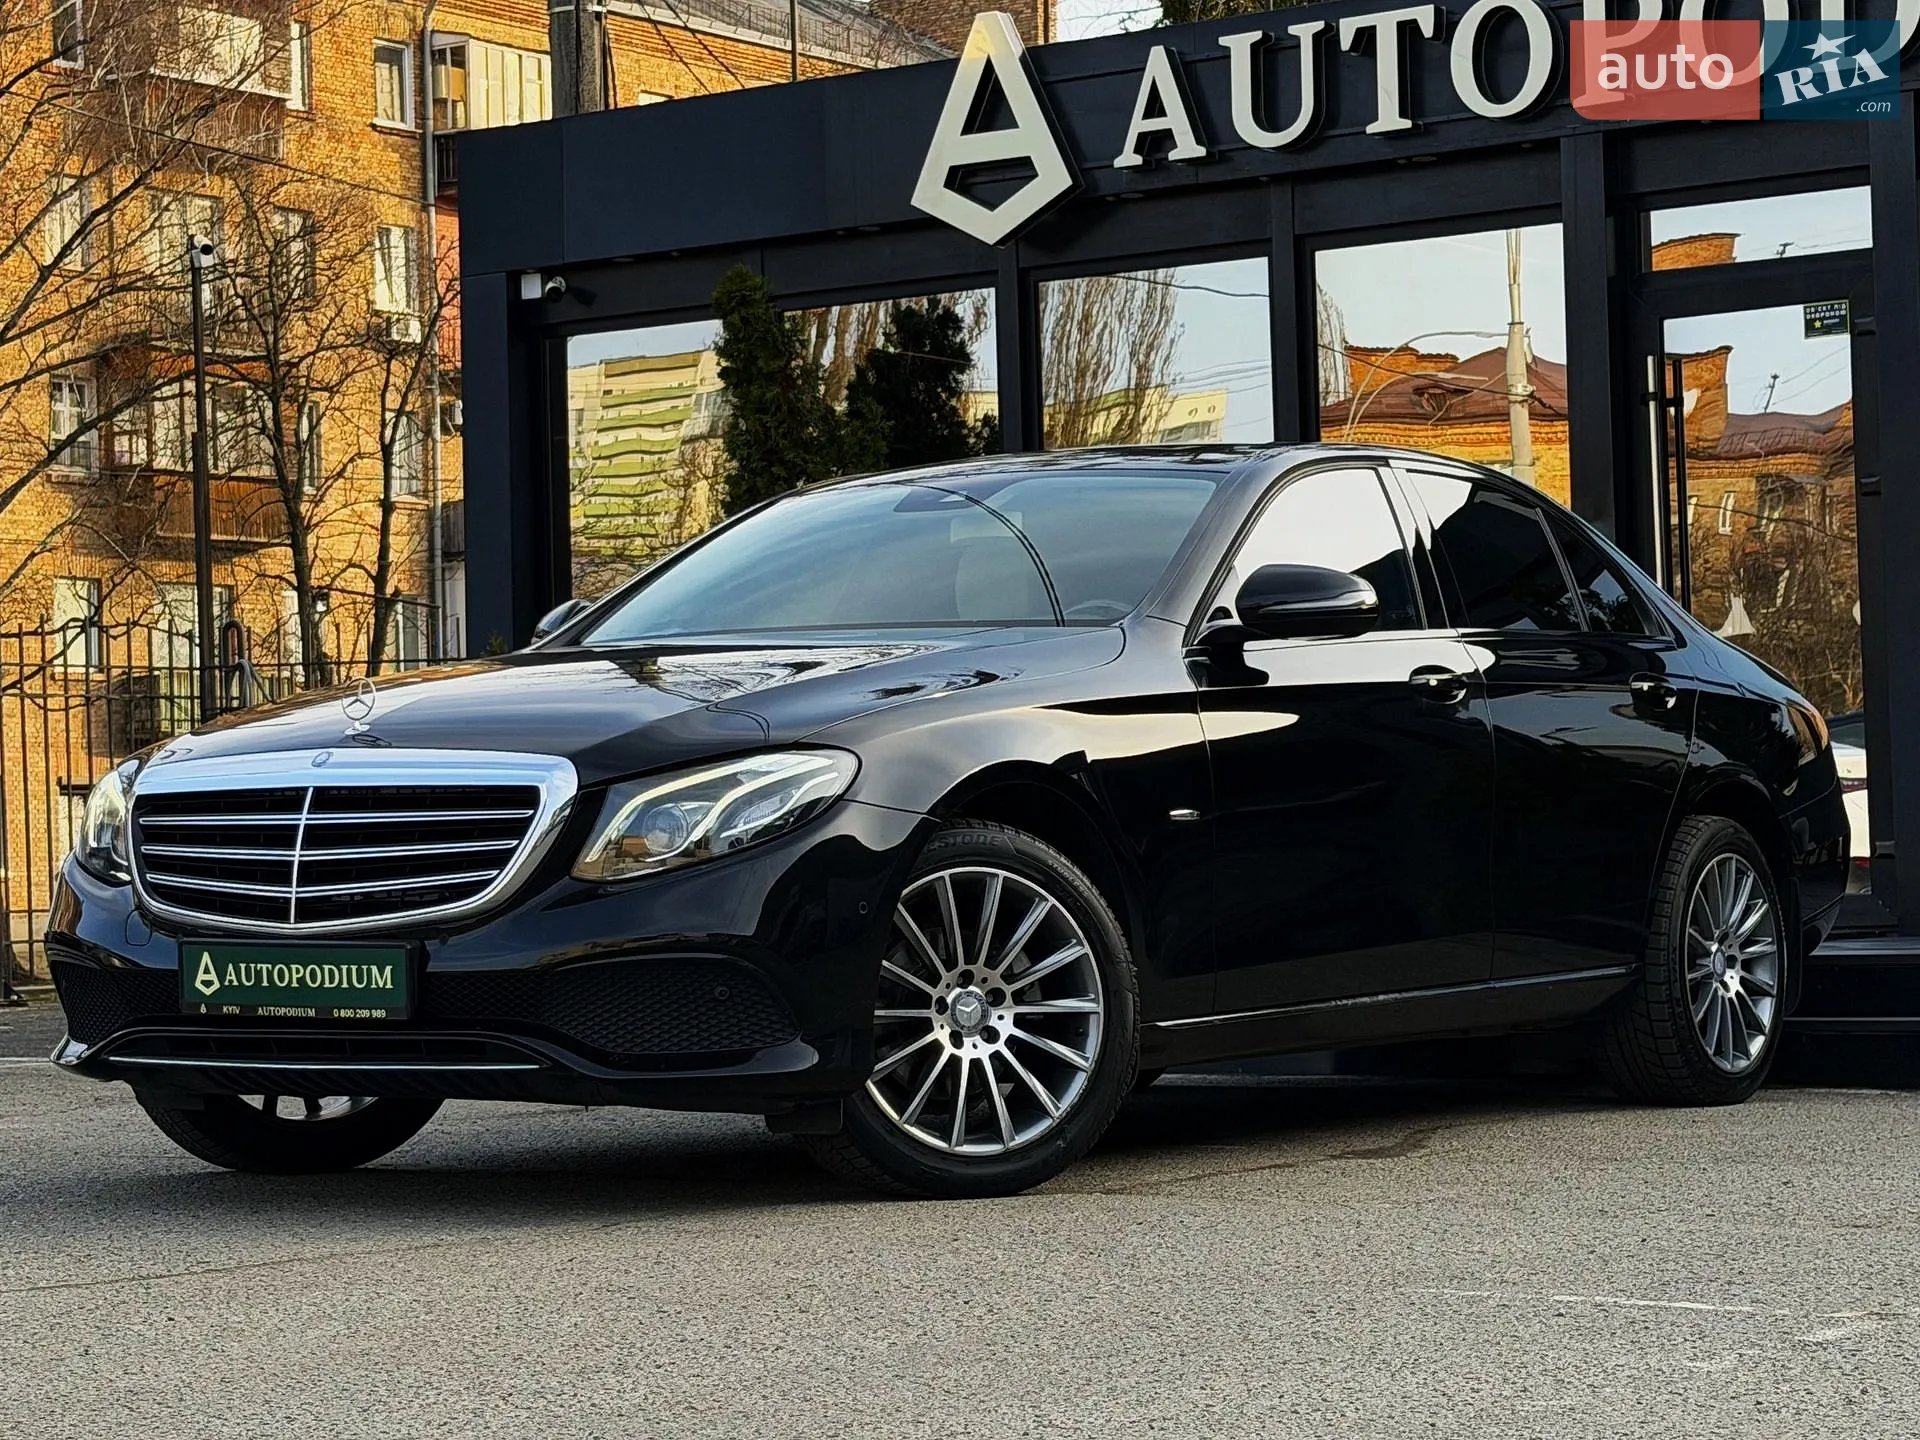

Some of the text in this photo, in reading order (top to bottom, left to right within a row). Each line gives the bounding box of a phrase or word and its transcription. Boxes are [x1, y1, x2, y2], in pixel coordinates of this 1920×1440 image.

[224, 962, 394, 989] AUTOPODIUM
[222, 1005, 386, 1019] KYIV AUTOPODIUM 0 800 209 989
